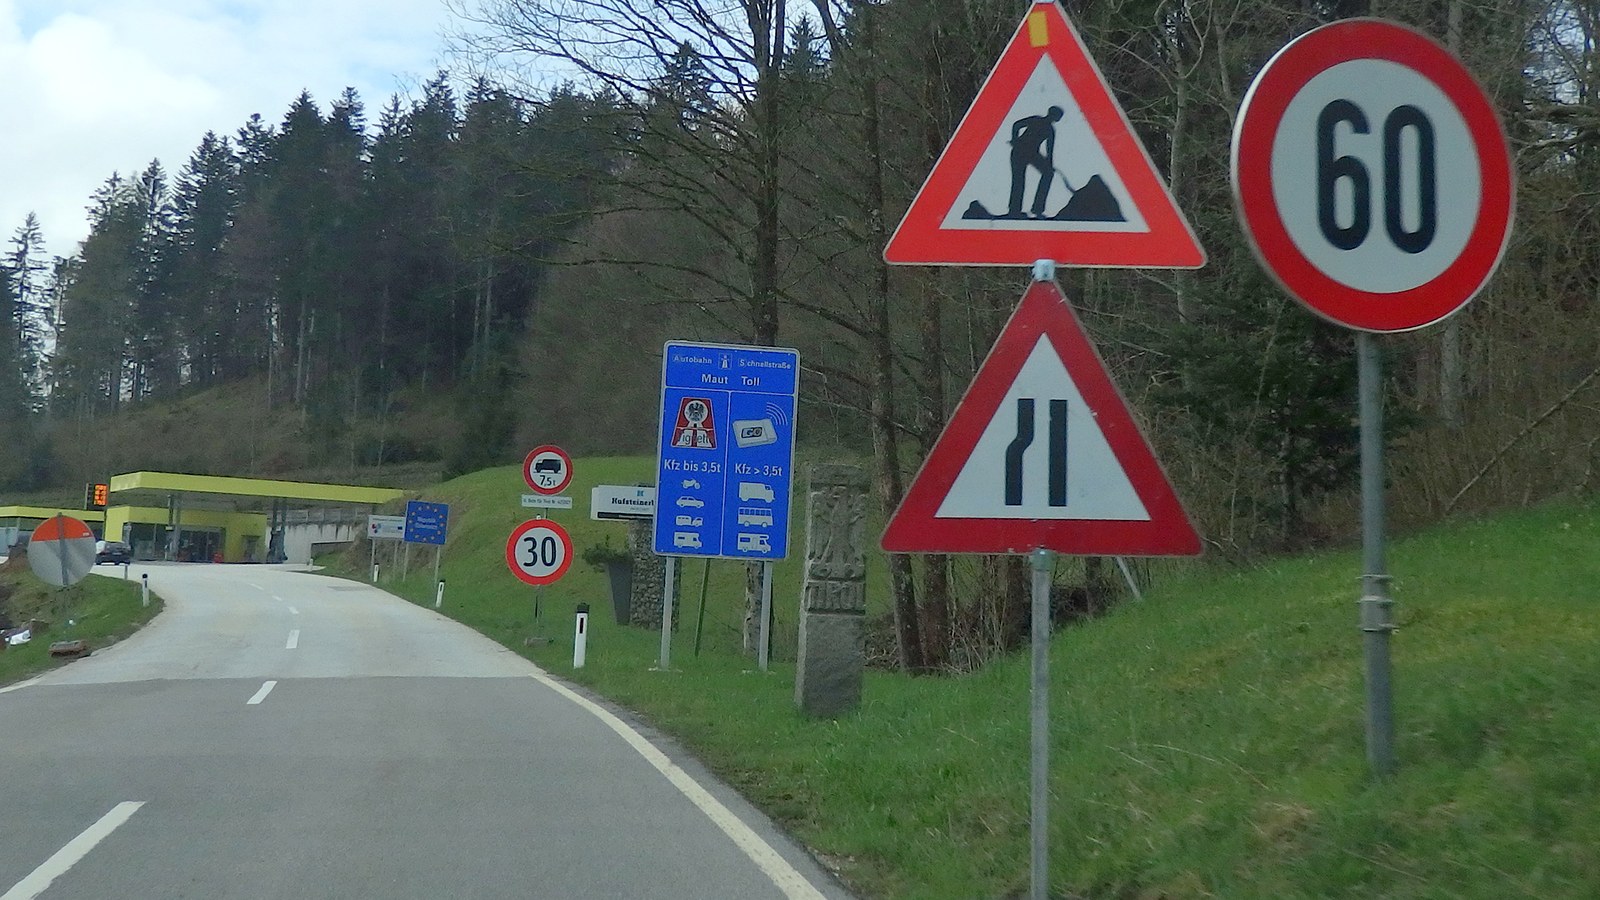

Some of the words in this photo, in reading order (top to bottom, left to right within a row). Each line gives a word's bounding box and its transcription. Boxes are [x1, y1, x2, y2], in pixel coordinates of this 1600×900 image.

[1317, 98, 1437, 254] 60
[674, 354, 712, 364] Autobahn
[739, 359, 791, 370] Schnellstraße
[702, 374, 728, 384] Maut
[741, 376, 760, 386] Toll
[664, 459, 680, 471] Kfz
[683, 460, 699, 472] bis
[701, 462, 721, 474] 3,5t
[735, 463, 751, 475] Kfz
[763, 465, 782, 477] 3,5t
[540, 475, 556, 487] 7,5t
[611, 497, 655, 506] Kufsteinerl
[523, 536, 557, 567] 30
